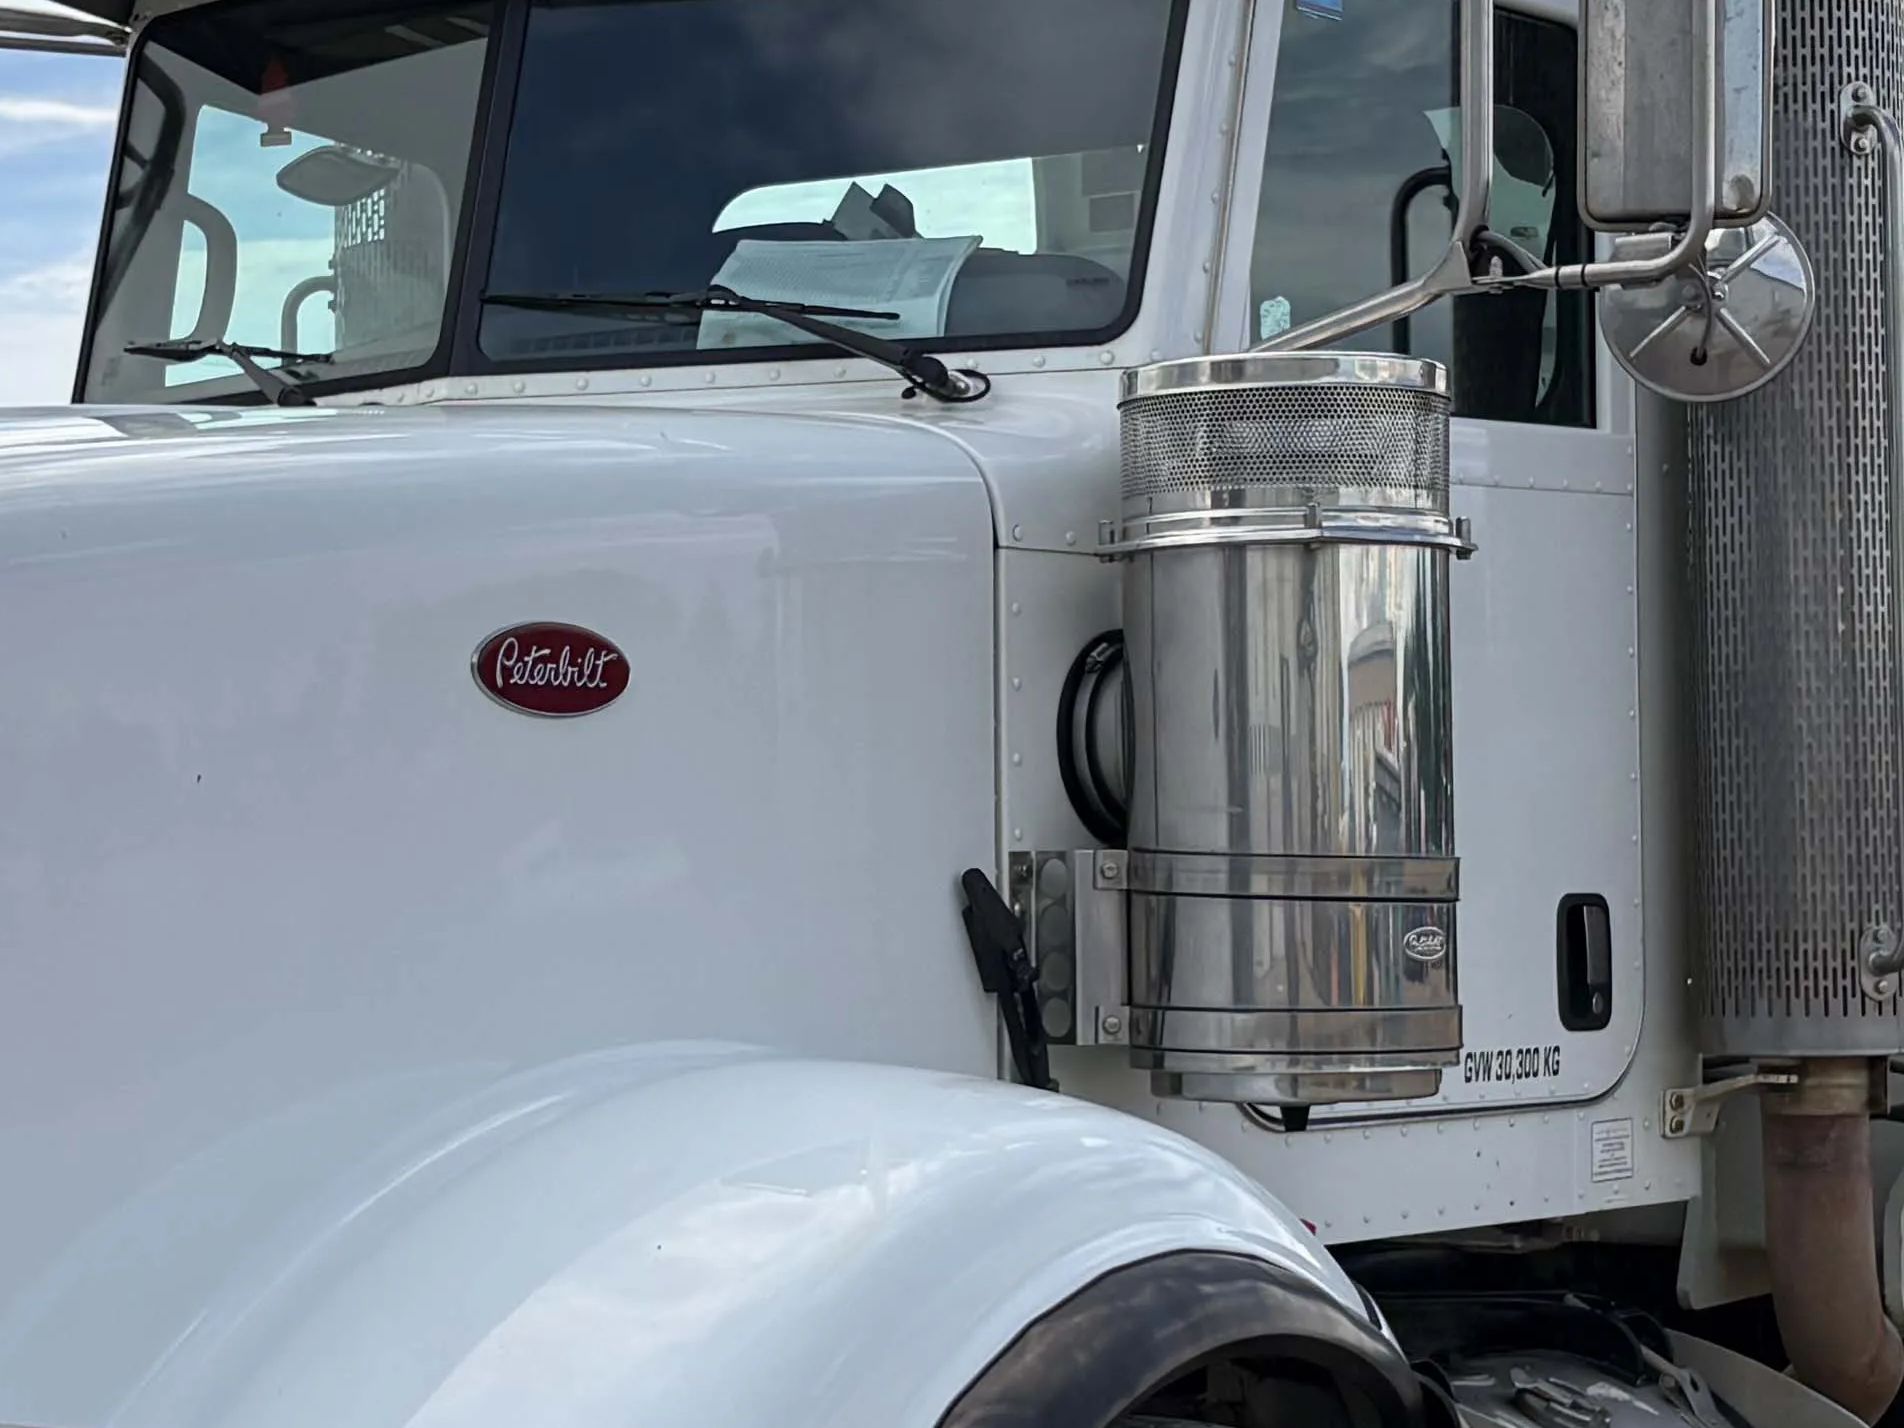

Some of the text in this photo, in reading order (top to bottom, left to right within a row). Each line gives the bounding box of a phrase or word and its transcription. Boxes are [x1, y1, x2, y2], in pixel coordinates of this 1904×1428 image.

[497, 637, 618, 688] Peterbilt
[1464, 1045, 1560, 1084] GVW 30,300 KG
